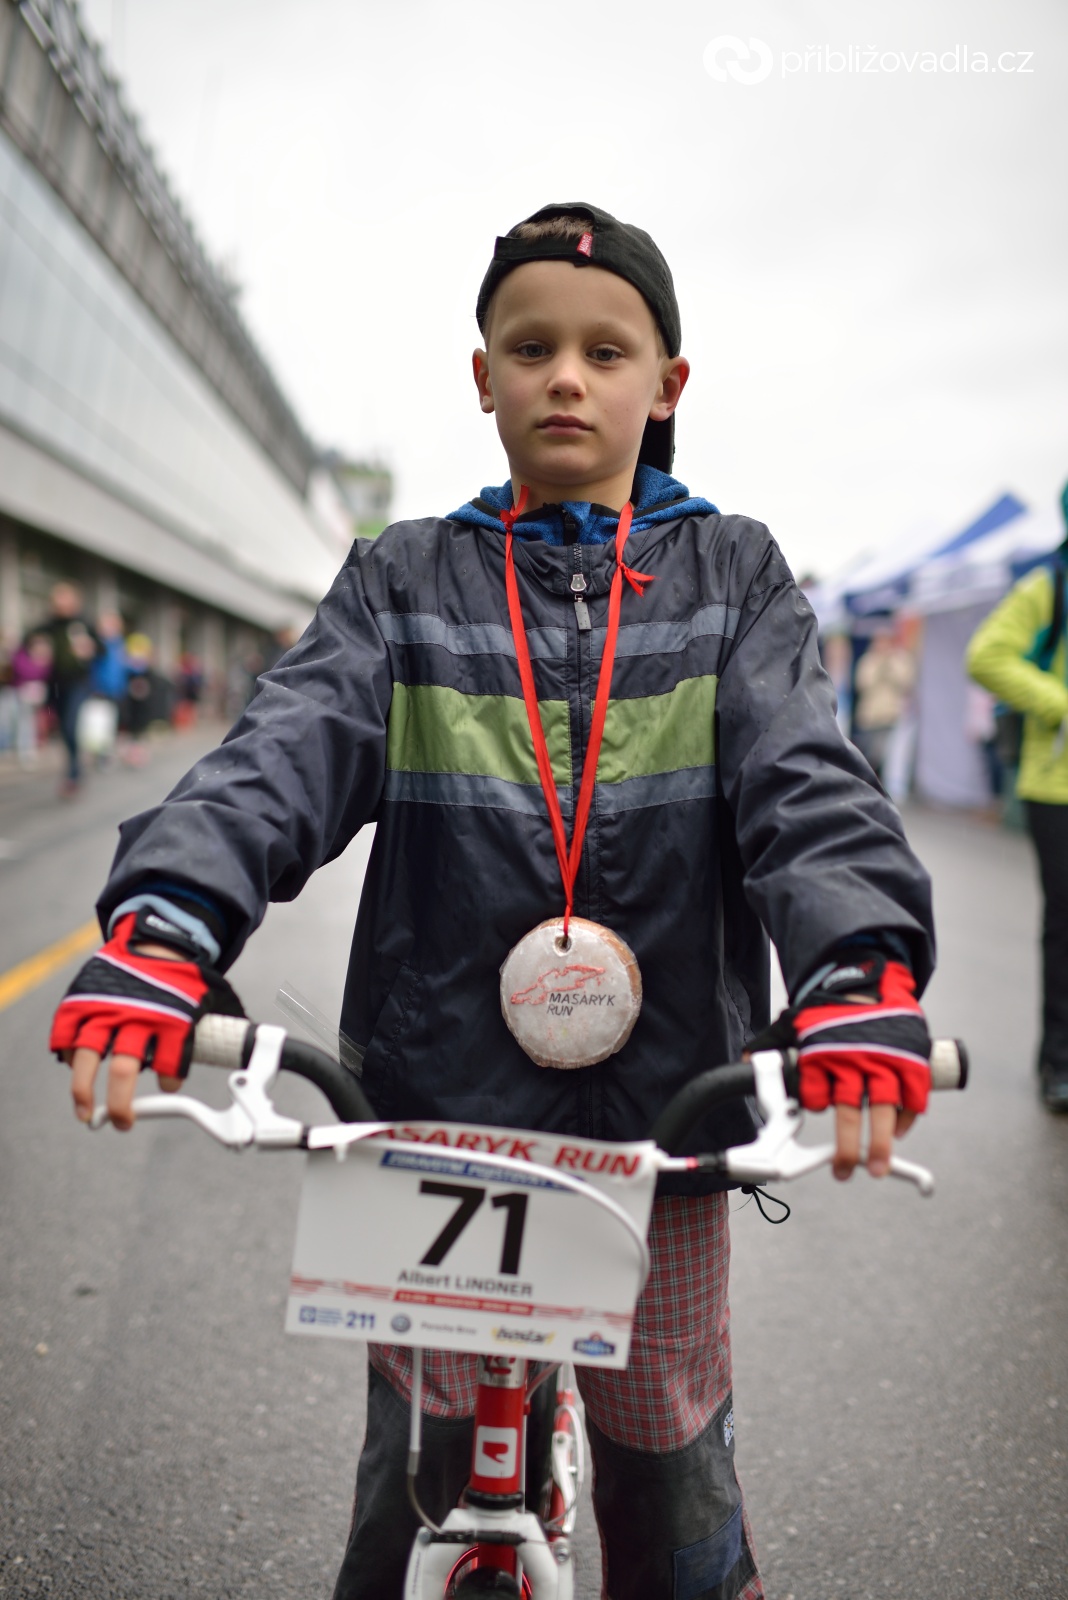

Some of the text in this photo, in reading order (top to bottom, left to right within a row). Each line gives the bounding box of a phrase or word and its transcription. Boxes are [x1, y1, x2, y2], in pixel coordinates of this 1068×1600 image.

[547, 1004, 574, 1016] RUN
[550, 993, 615, 1007] MASARYK
[367, 1126, 641, 1177] ASARYK RUN
[418, 1179, 530, 1276] 71
[397, 1270, 533, 1297] Albert LINDNER
[345, 1309, 376, 1331] 211
